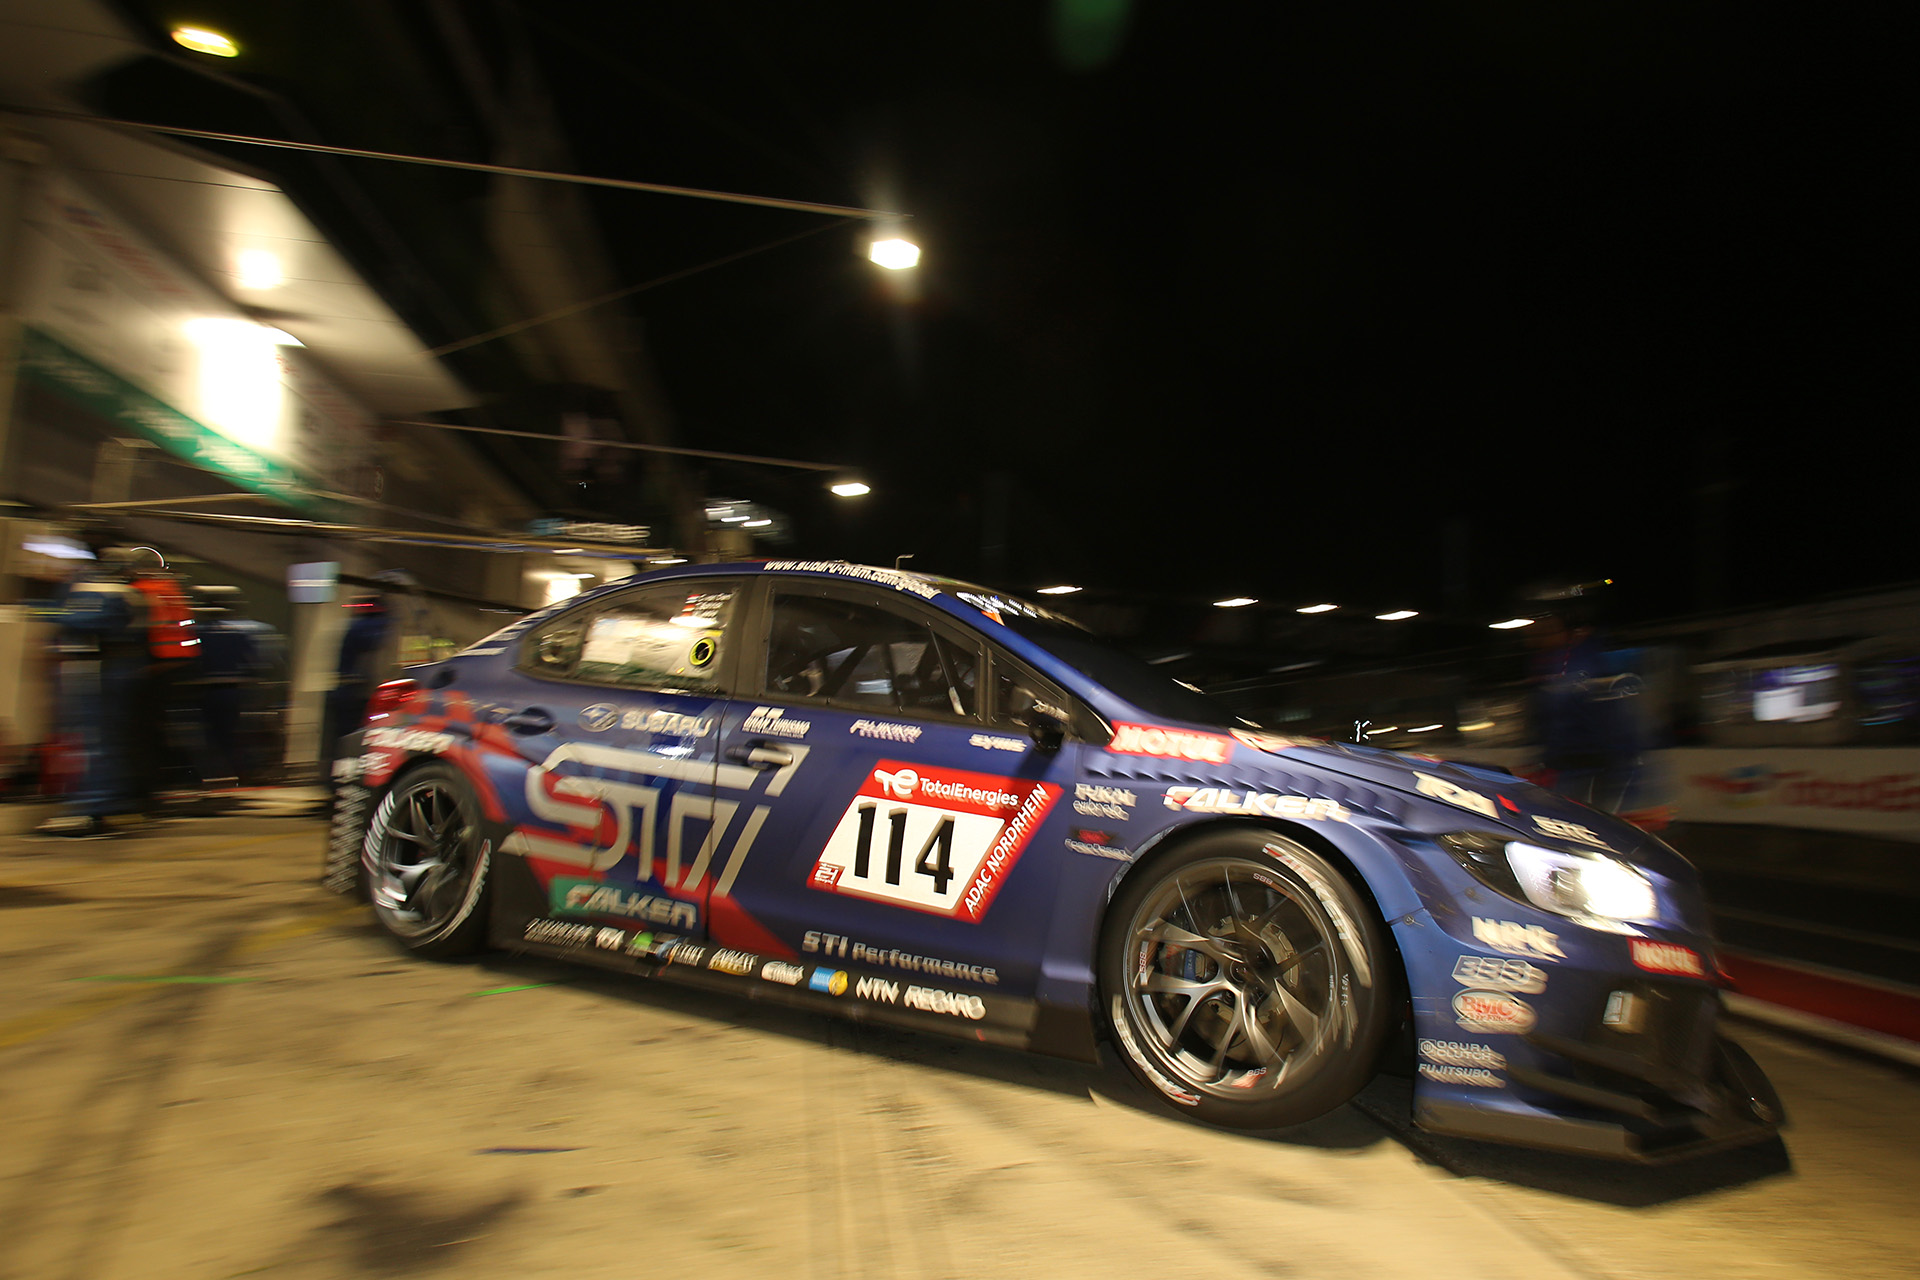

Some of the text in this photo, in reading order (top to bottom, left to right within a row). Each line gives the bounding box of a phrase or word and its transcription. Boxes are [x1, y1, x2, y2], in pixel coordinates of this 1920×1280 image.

[621, 710, 713, 737] SUBARU
[1111, 725, 1226, 763] MOTUL
[920, 777, 1018, 806] TotalEnergies
[1163, 786, 1350, 822] FALKEN
[855, 803, 954, 894] 114
[963, 783, 1047, 914] ADAC NORDRHEIN
[565, 884, 696, 928] FALKEN
[802, 930, 848, 958] STI
[852, 942, 999, 985] Performance
[1633, 941, 1704, 975] MOTUL
[856, 975, 899, 1004] NTN
[903, 984, 986, 1020] RECARO
[1460, 996, 1516, 1016] BMC
[1436, 1041, 1494, 1053] OGURA
[1436, 1049, 1494, 1062] CLUTCH
[1418, 1063, 1496, 1082] FUJITSUBO
